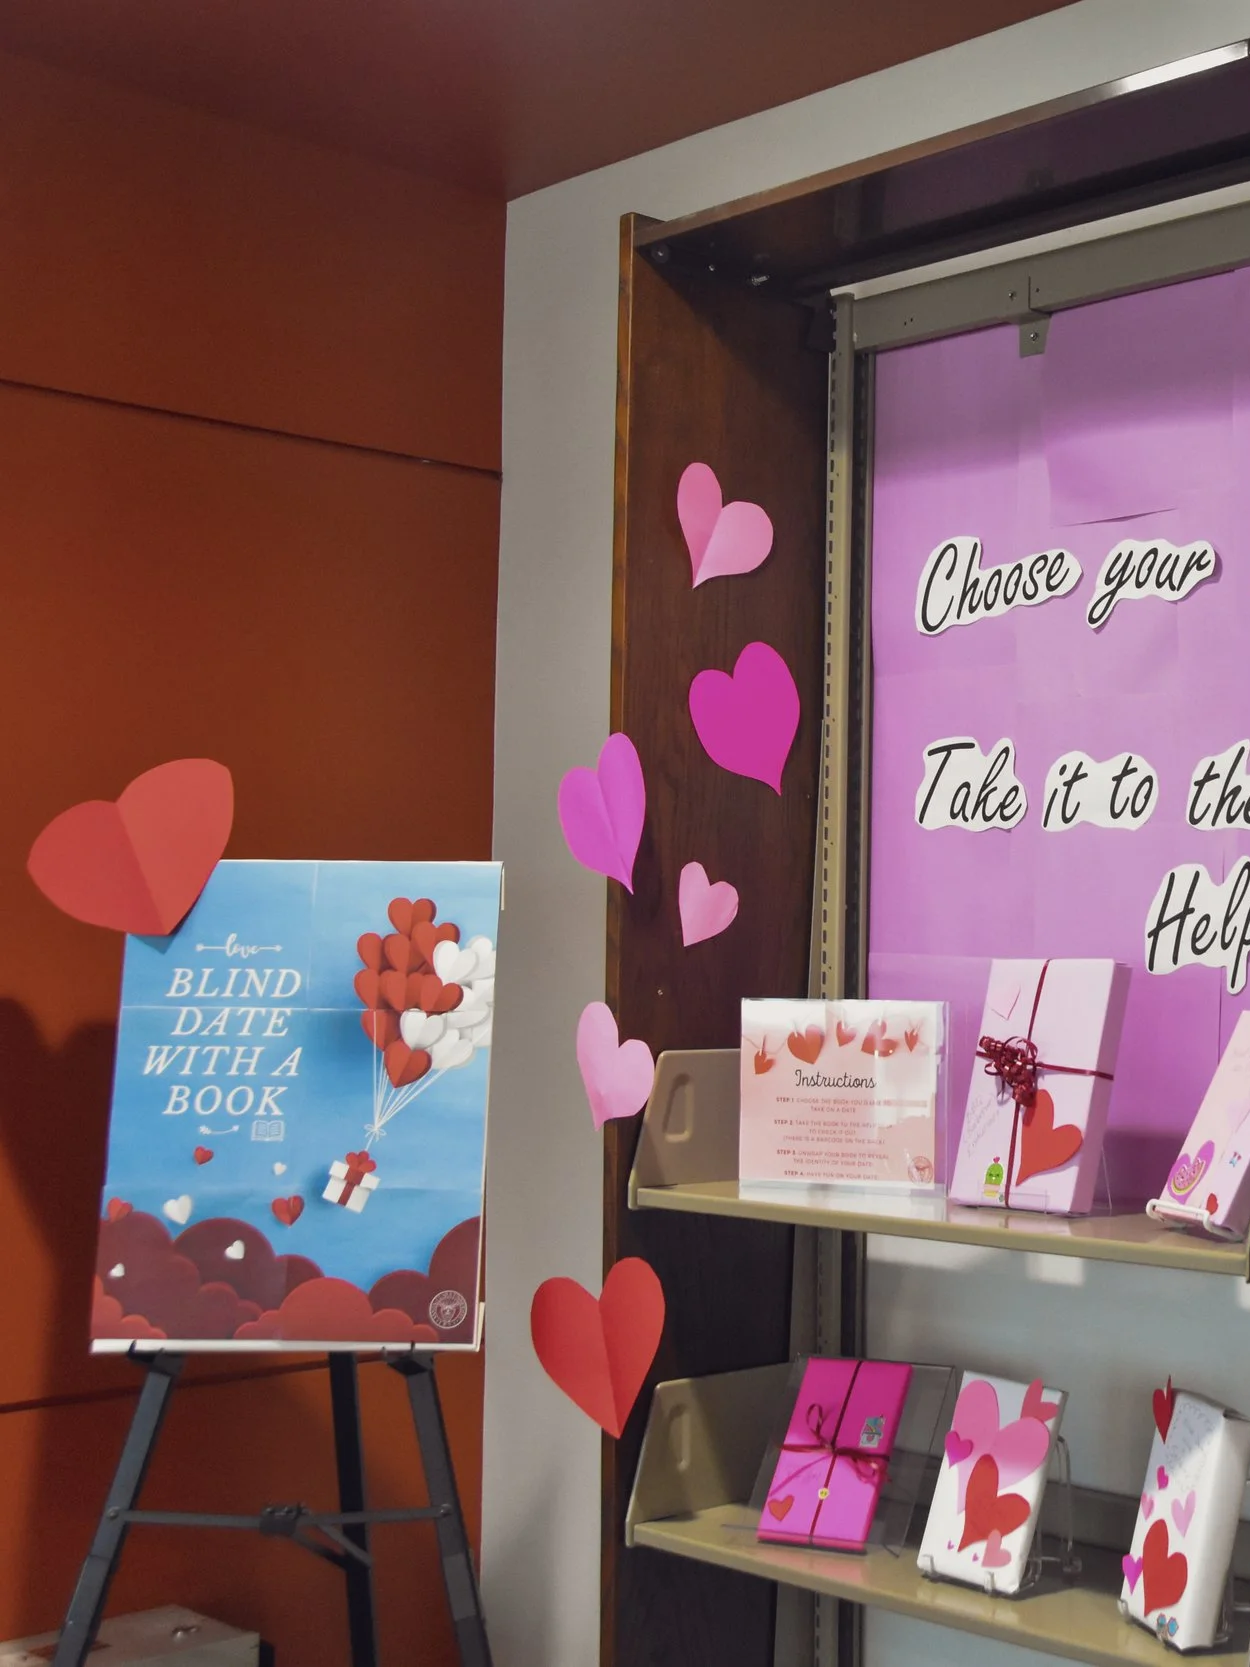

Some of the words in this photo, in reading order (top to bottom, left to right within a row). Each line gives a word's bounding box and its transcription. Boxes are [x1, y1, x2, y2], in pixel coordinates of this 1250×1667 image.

[921, 541, 1070, 633] Choose
[1086, 543, 1212, 625] your
[917, 741, 1023, 825] Take
[1041, 762, 1088, 829] it
[1110, 755, 1156, 819] to
[224, 932, 261, 959] love
[165, 967, 302, 998] BLIND
[170, 1006, 292, 1037] DATE
[142, 1045, 266, 1076] WITH
[270, 1046, 303, 1077] A
[794, 1068, 878, 1090] Instructions
[162, 1084, 289, 1117] BOOK
